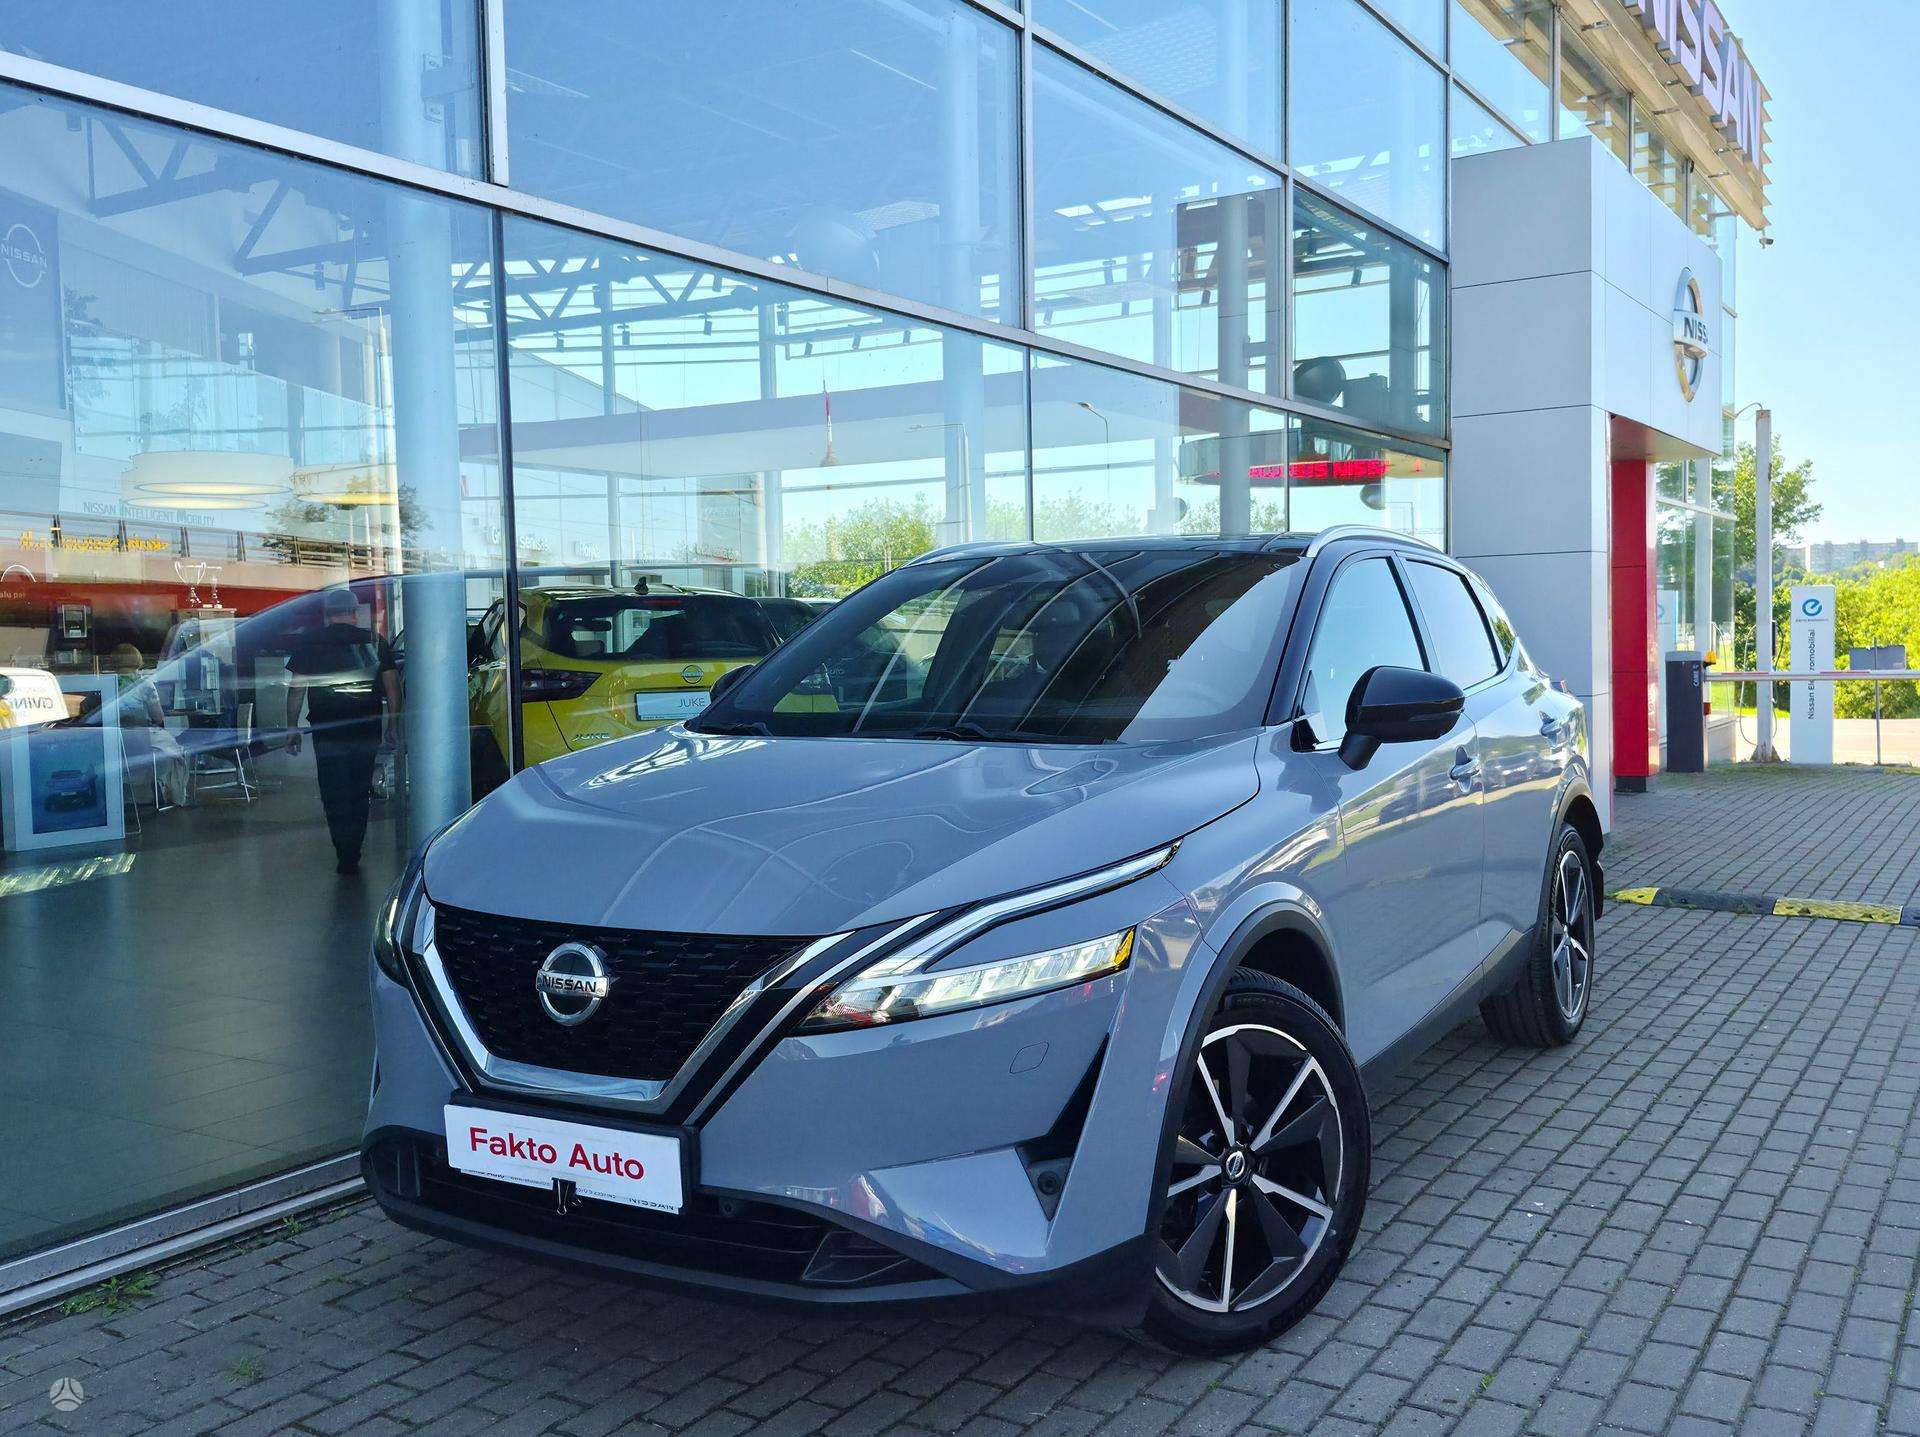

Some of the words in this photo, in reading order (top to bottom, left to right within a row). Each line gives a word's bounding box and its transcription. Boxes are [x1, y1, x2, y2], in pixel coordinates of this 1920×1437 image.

[1638, 0, 1761, 169] SSAN
[1, 243, 47, 268] NISSAN
[1684, 316, 1708, 344] NISS
[679, 697, 705, 707] JUKE
[1808, 693, 1816, 720] Nissan
[542, 975, 597, 993] NISSAN
[469, 1126, 558, 1164] Fakto
[568, 1143, 645, 1180] Auto
